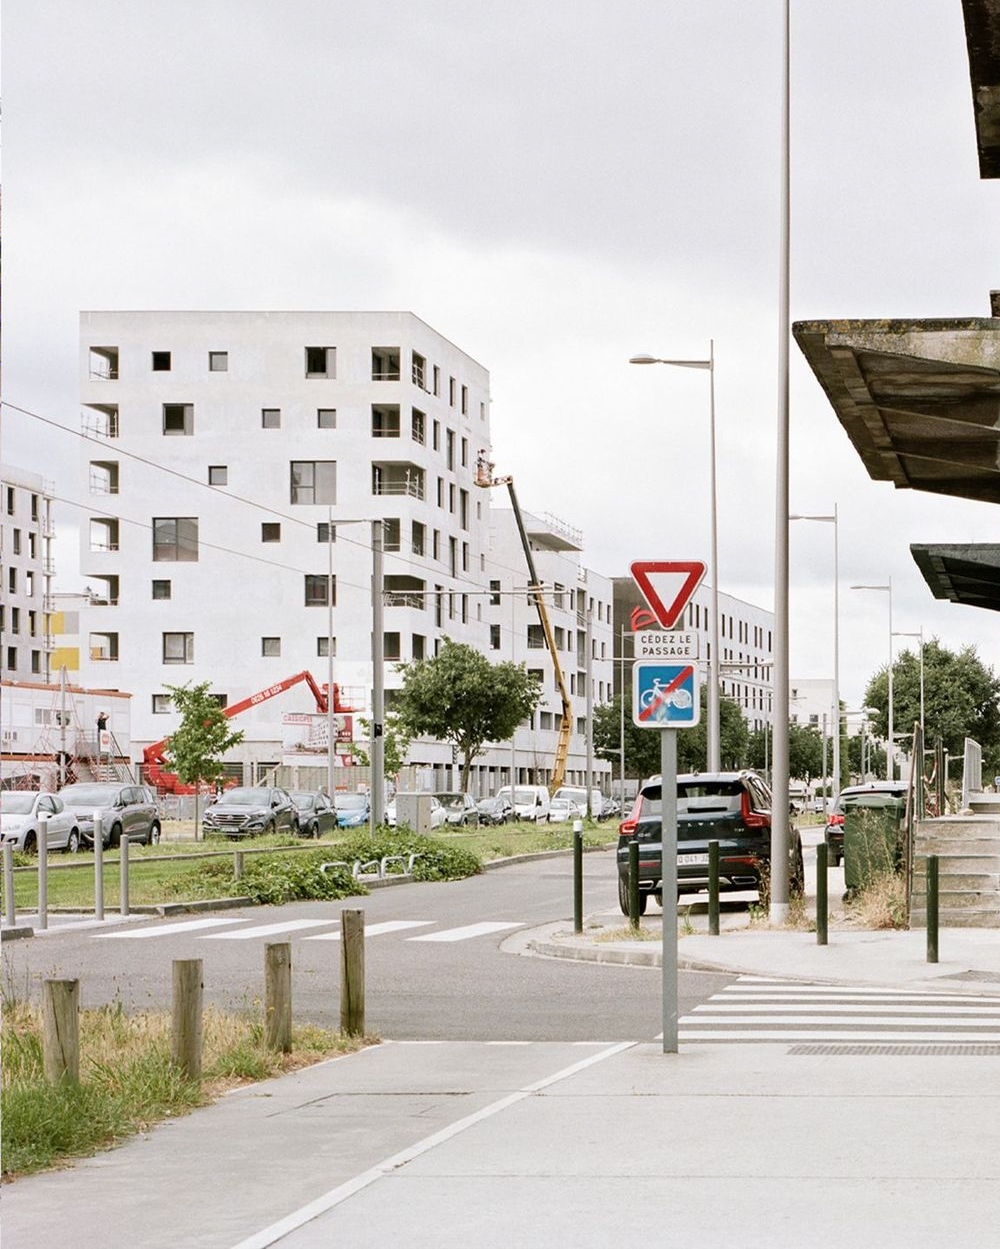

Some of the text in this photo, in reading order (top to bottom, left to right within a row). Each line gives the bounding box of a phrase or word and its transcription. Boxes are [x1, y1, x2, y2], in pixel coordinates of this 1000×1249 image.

[641, 634, 692, 644] CÉDEZ LE
[642, 646, 691, 656] PASSAGE
